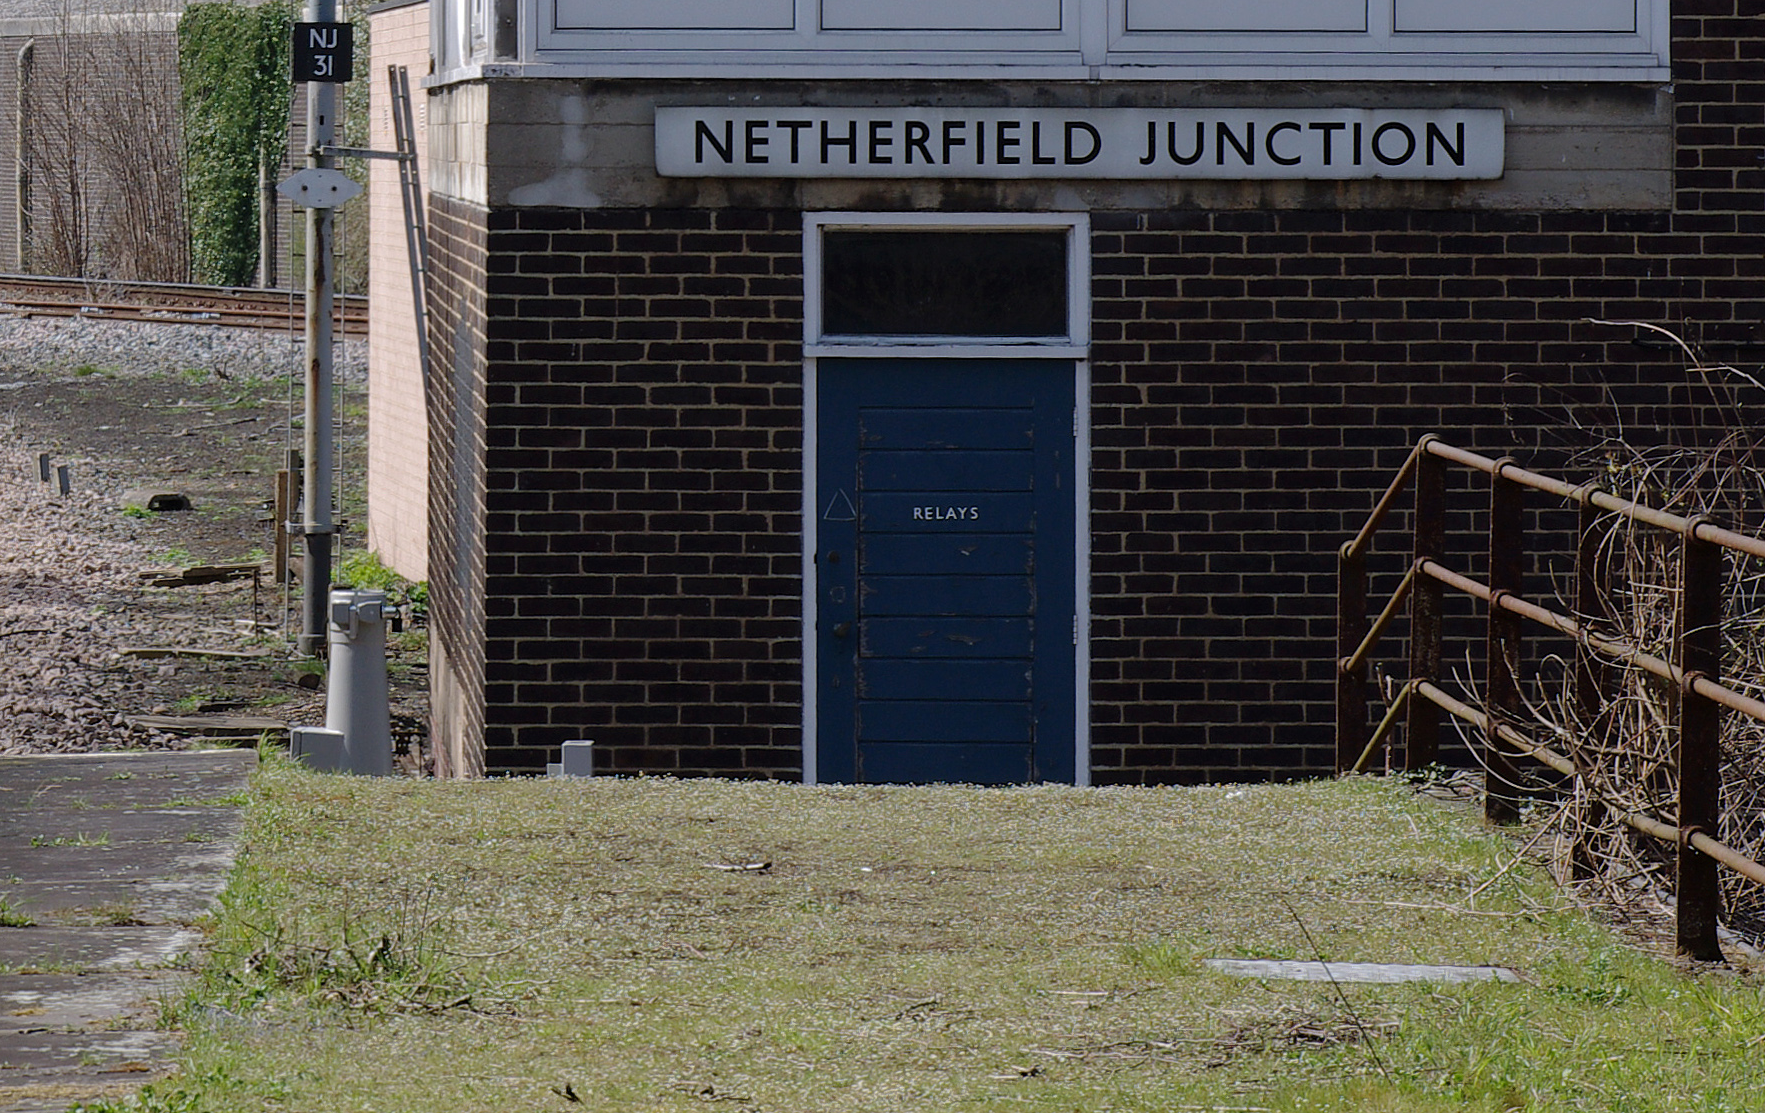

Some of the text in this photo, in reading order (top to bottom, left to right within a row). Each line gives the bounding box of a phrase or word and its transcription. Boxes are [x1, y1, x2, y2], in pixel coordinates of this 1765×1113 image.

[309, 28, 338, 49] NJ
[313, 55, 333, 76] 31
[695, 120, 1466, 166] NETHERFIELD JUNCTION
[913, 506, 978, 520] RELAYS
